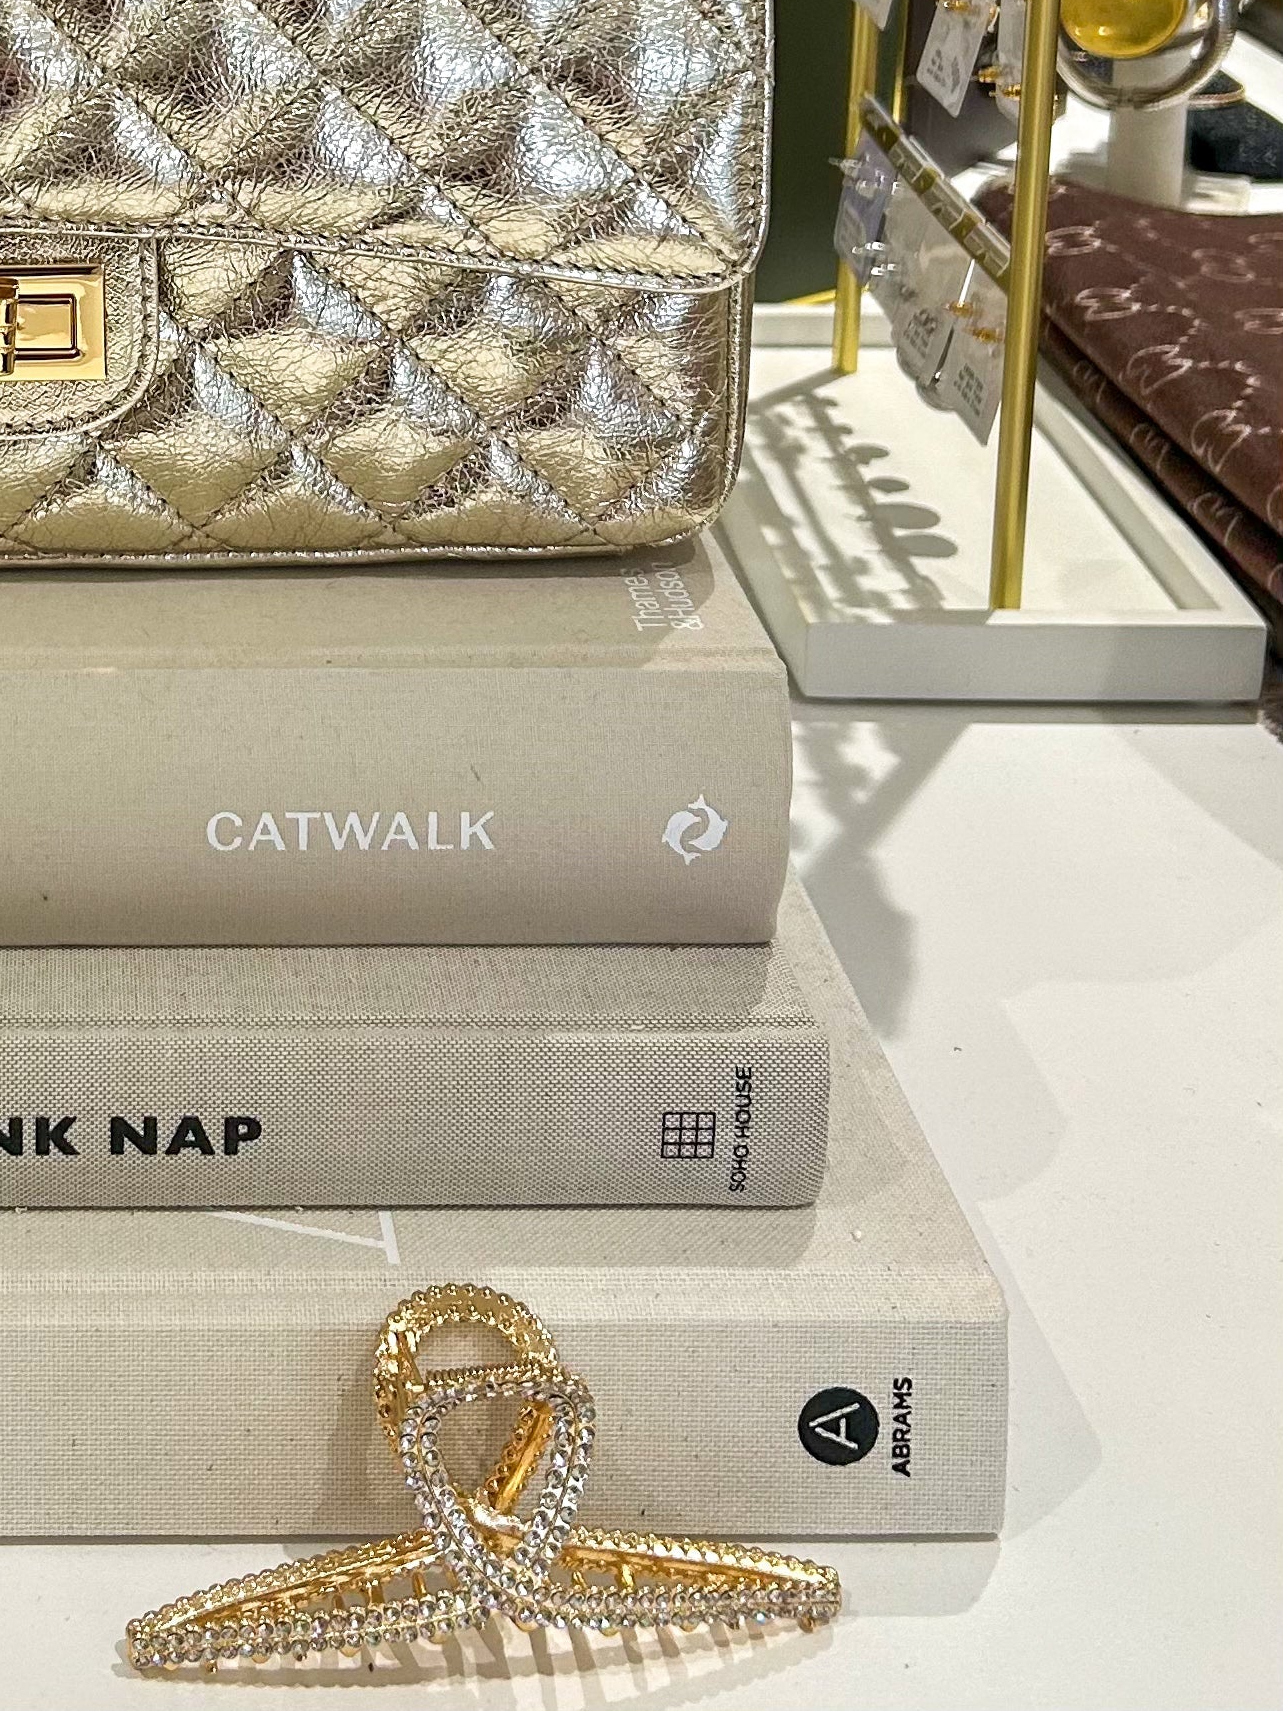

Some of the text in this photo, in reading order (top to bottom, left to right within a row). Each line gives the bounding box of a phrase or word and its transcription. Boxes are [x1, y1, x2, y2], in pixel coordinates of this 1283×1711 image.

[620, 568, 668, 631] Thames
[206, 810, 495, 851] CATWALK
[109, 1116, 263, 1158] NAP
[729, 1066, 753, 1193] SOHO HOUSE
[891, 1376, 913, 1478] ABRAMS
